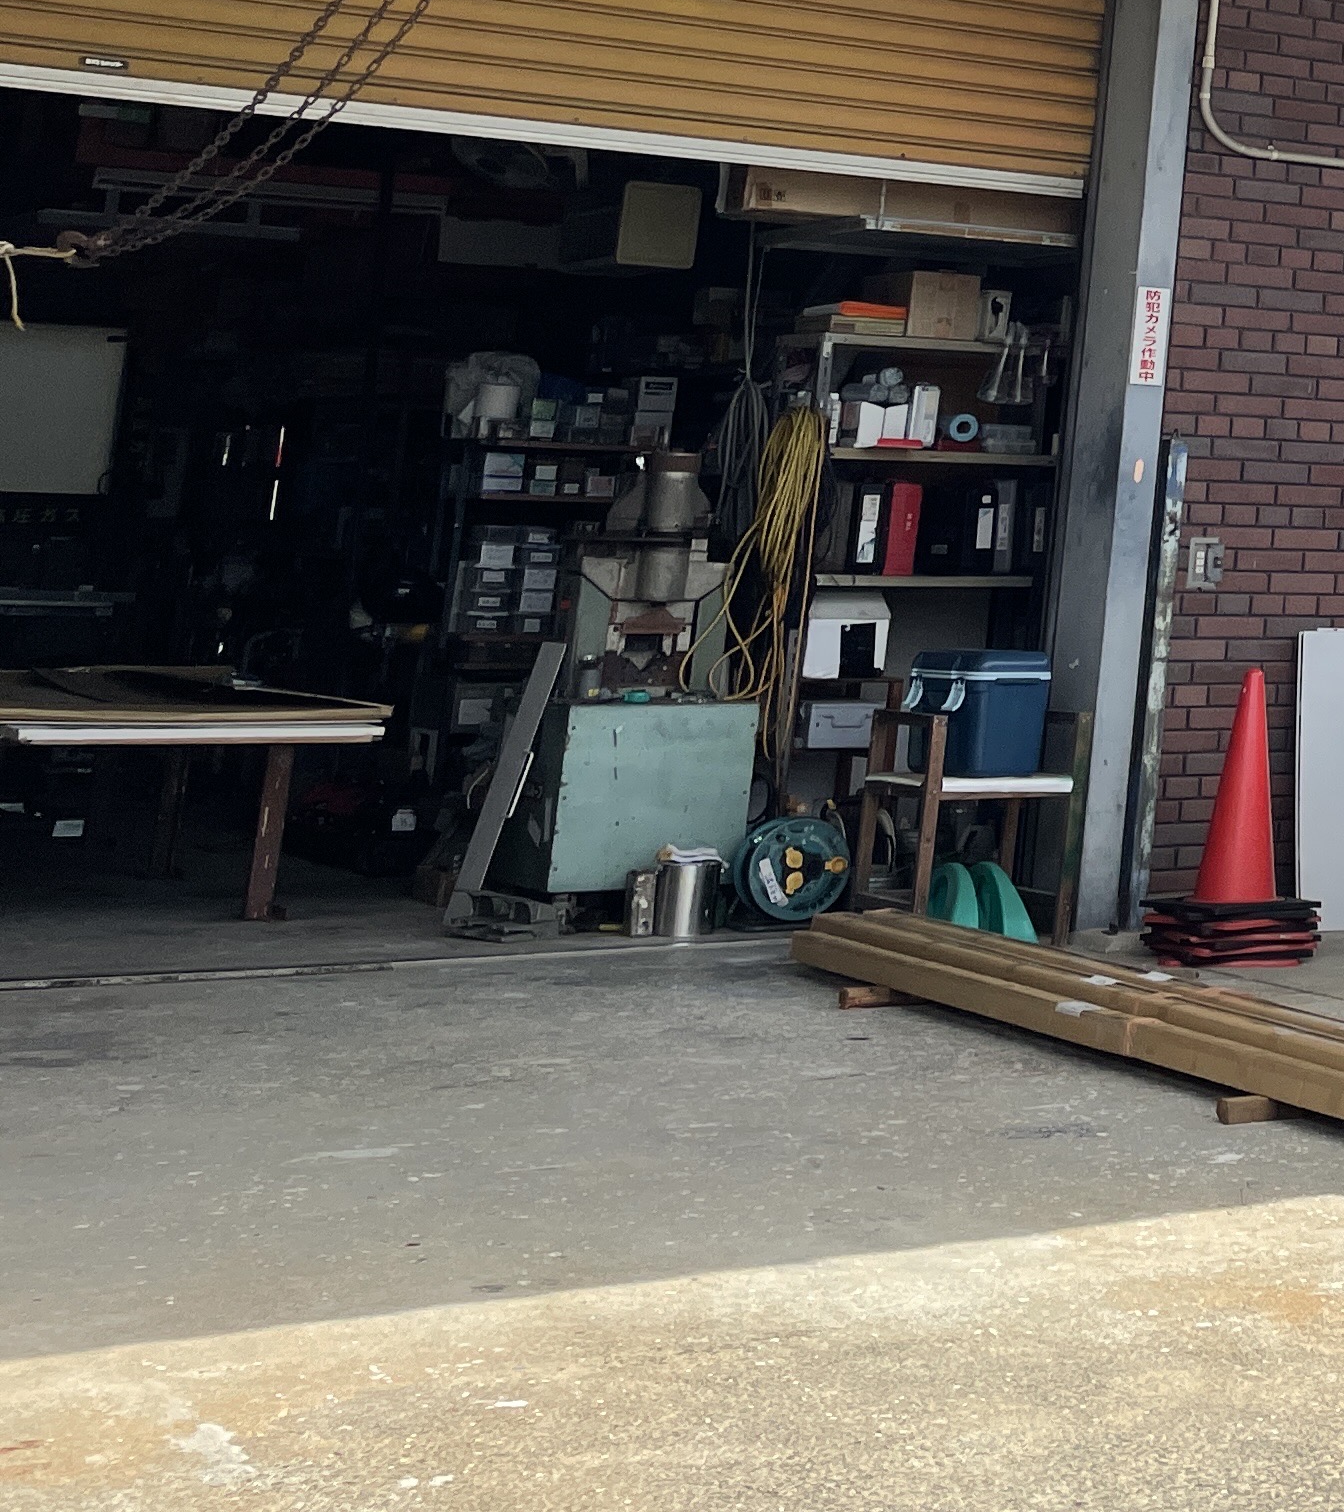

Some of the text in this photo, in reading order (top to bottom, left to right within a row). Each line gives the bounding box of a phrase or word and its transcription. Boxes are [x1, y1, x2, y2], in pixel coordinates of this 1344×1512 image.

[1139, 290, 1162, 382] 防犯カメラ作動中
